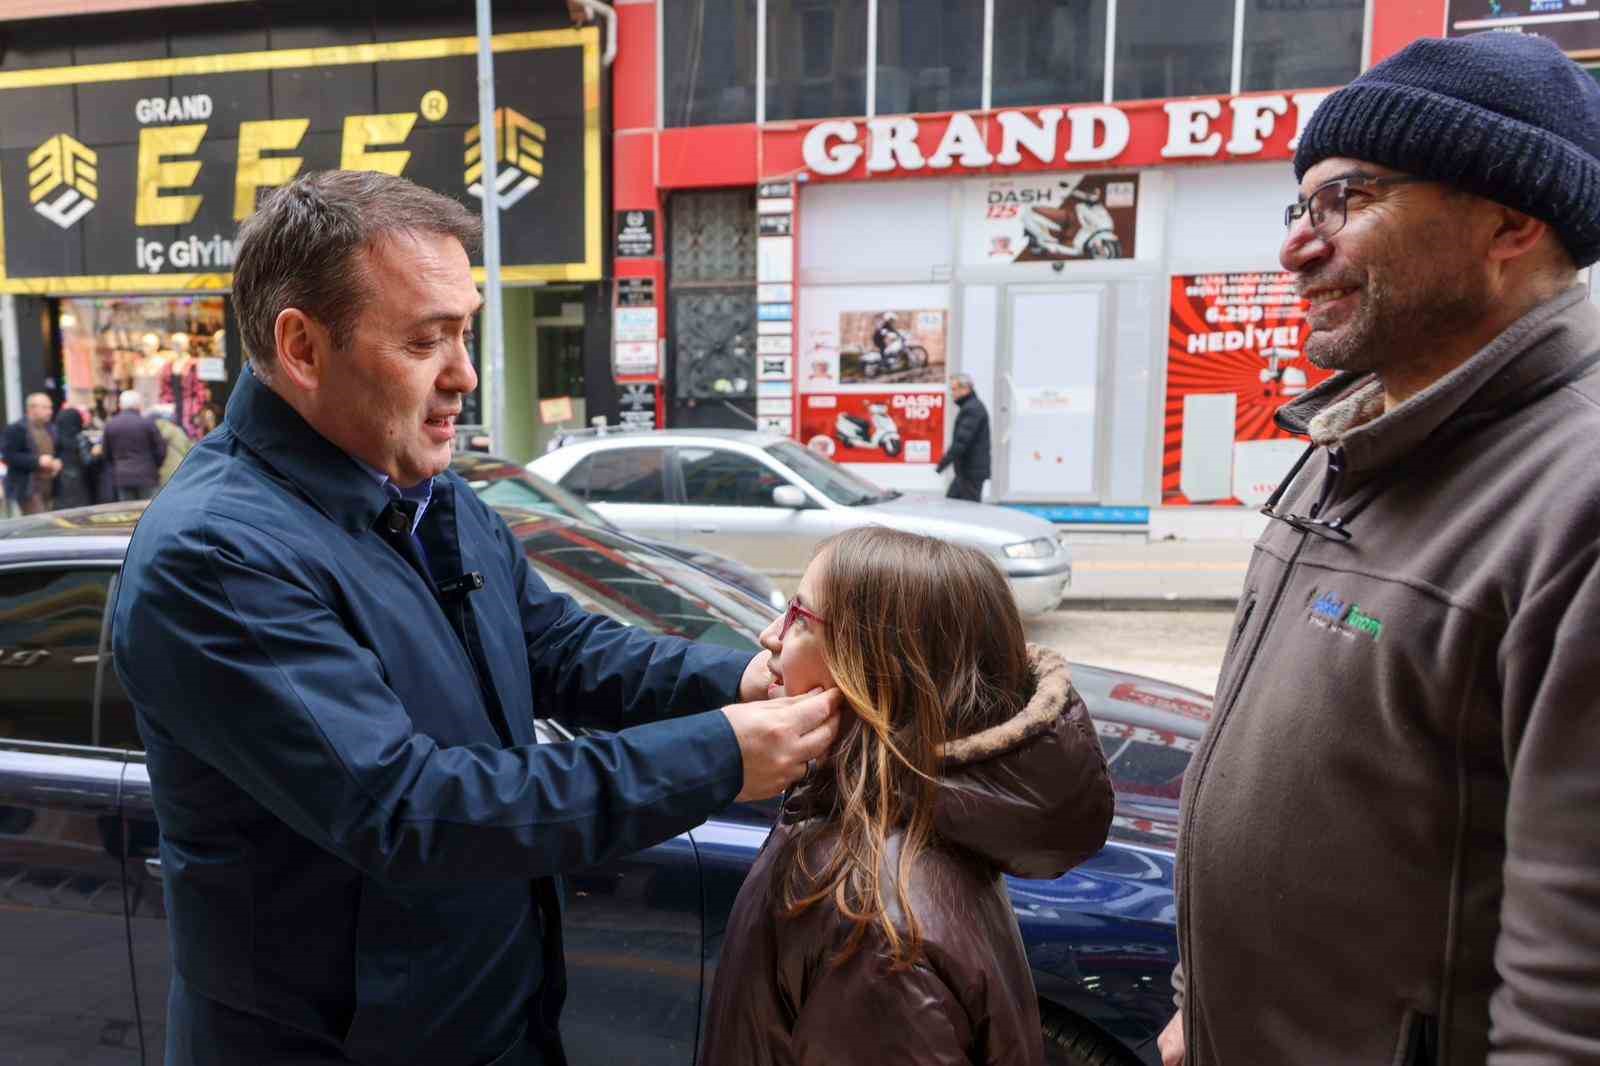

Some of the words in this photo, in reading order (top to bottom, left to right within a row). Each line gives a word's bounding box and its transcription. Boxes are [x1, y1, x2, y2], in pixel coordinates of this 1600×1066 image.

[135, 94, 214, 124] GRAND
[802, 105, 1131, 176] GRAND
[987, 188, 1053, 204] DASH
[136, 237, 165, 274] İÇ
[1187, 324, 1299, 353] HEDİYE!
